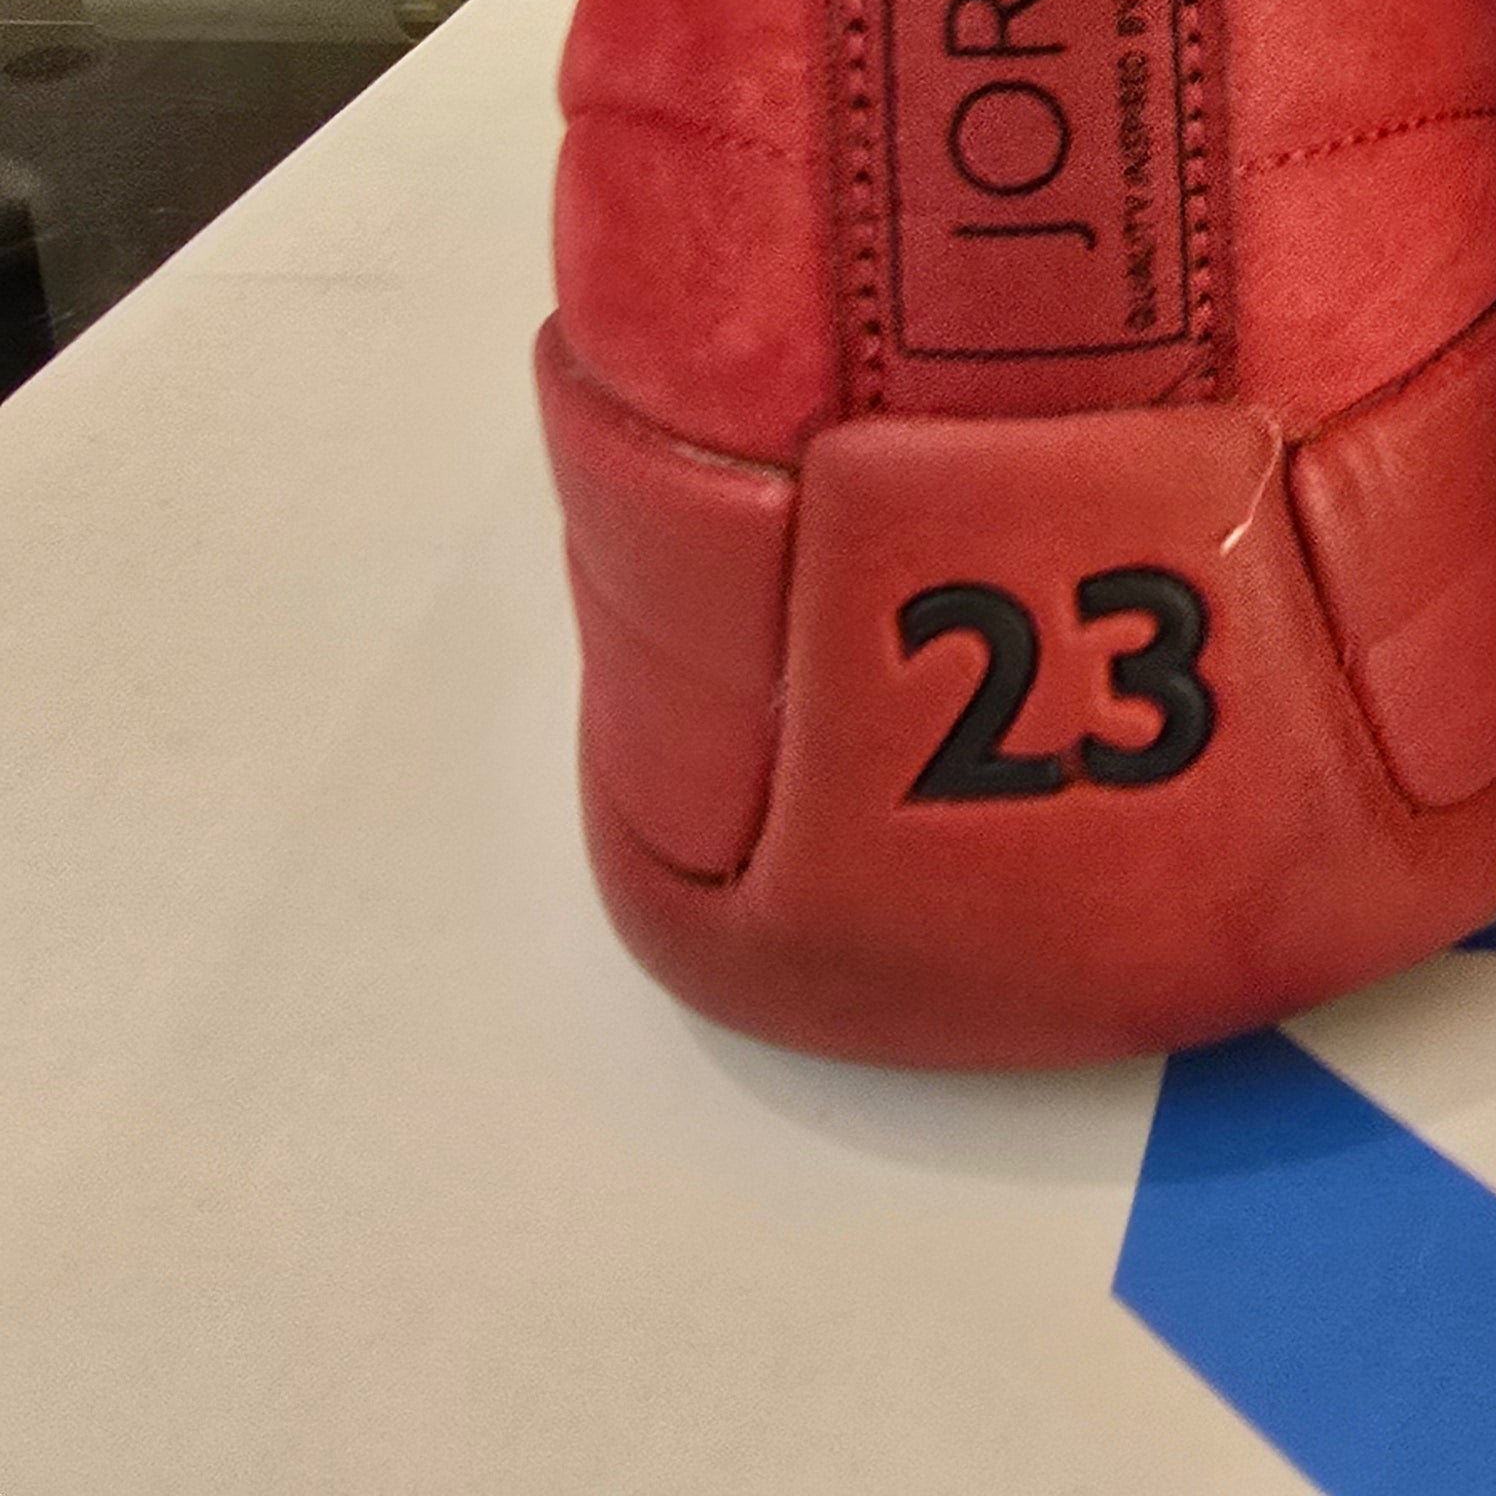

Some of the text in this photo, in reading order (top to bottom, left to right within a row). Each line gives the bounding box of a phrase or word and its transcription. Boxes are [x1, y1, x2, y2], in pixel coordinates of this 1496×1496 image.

[1116, 50, 1152, 187] INSPIRED
[1122, 195, 1158, 332] QUALITY
[896, 564, 1218, 806] 23
